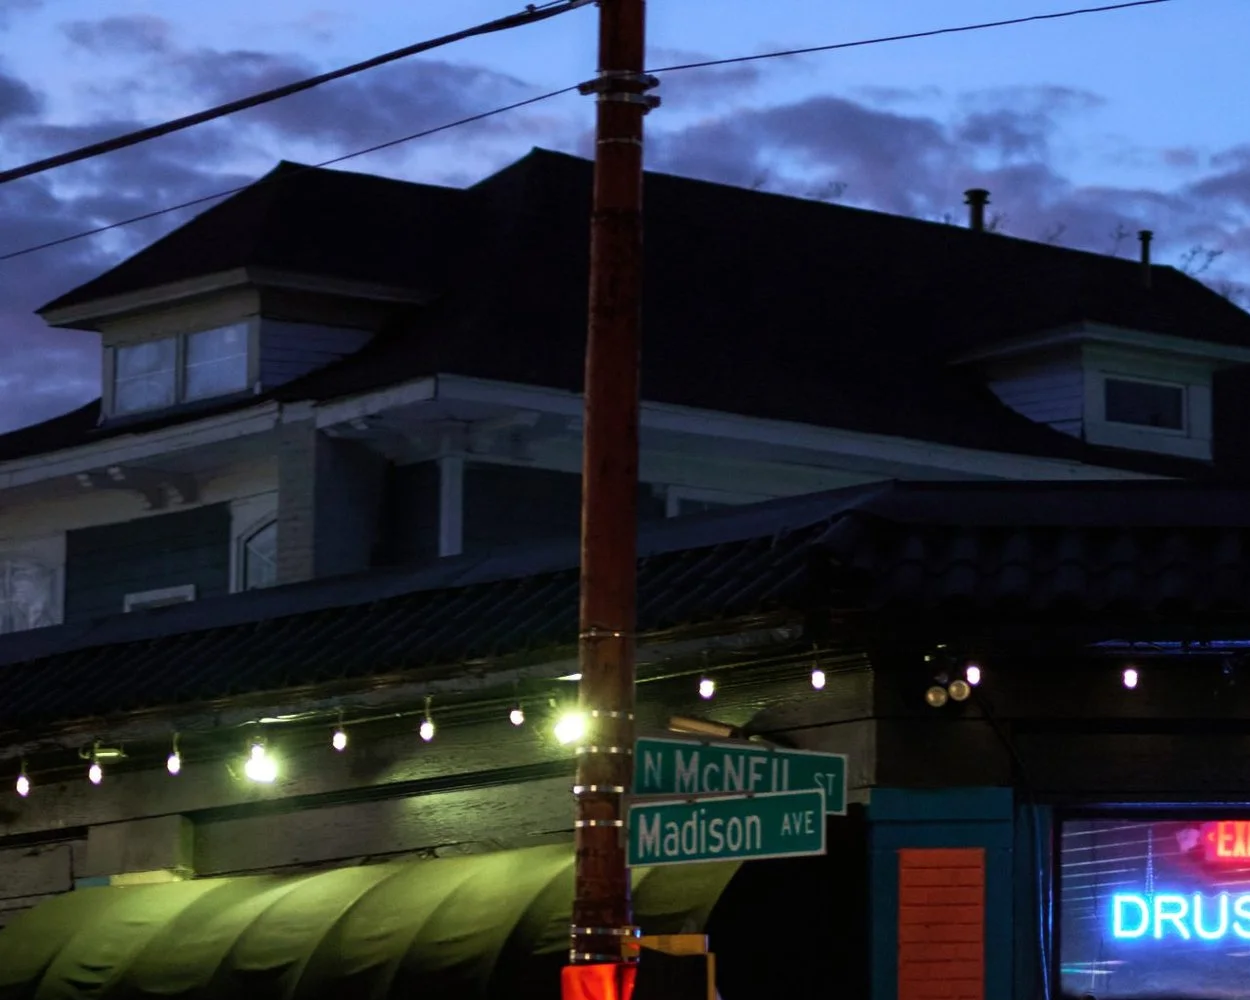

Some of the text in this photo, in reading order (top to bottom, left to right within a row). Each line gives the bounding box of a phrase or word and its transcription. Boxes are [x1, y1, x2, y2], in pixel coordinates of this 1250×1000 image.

[643, 751, 663, 789] N
[813, 772, 837, 797] ST
[637, 808, 816, 858] Madison AVE
